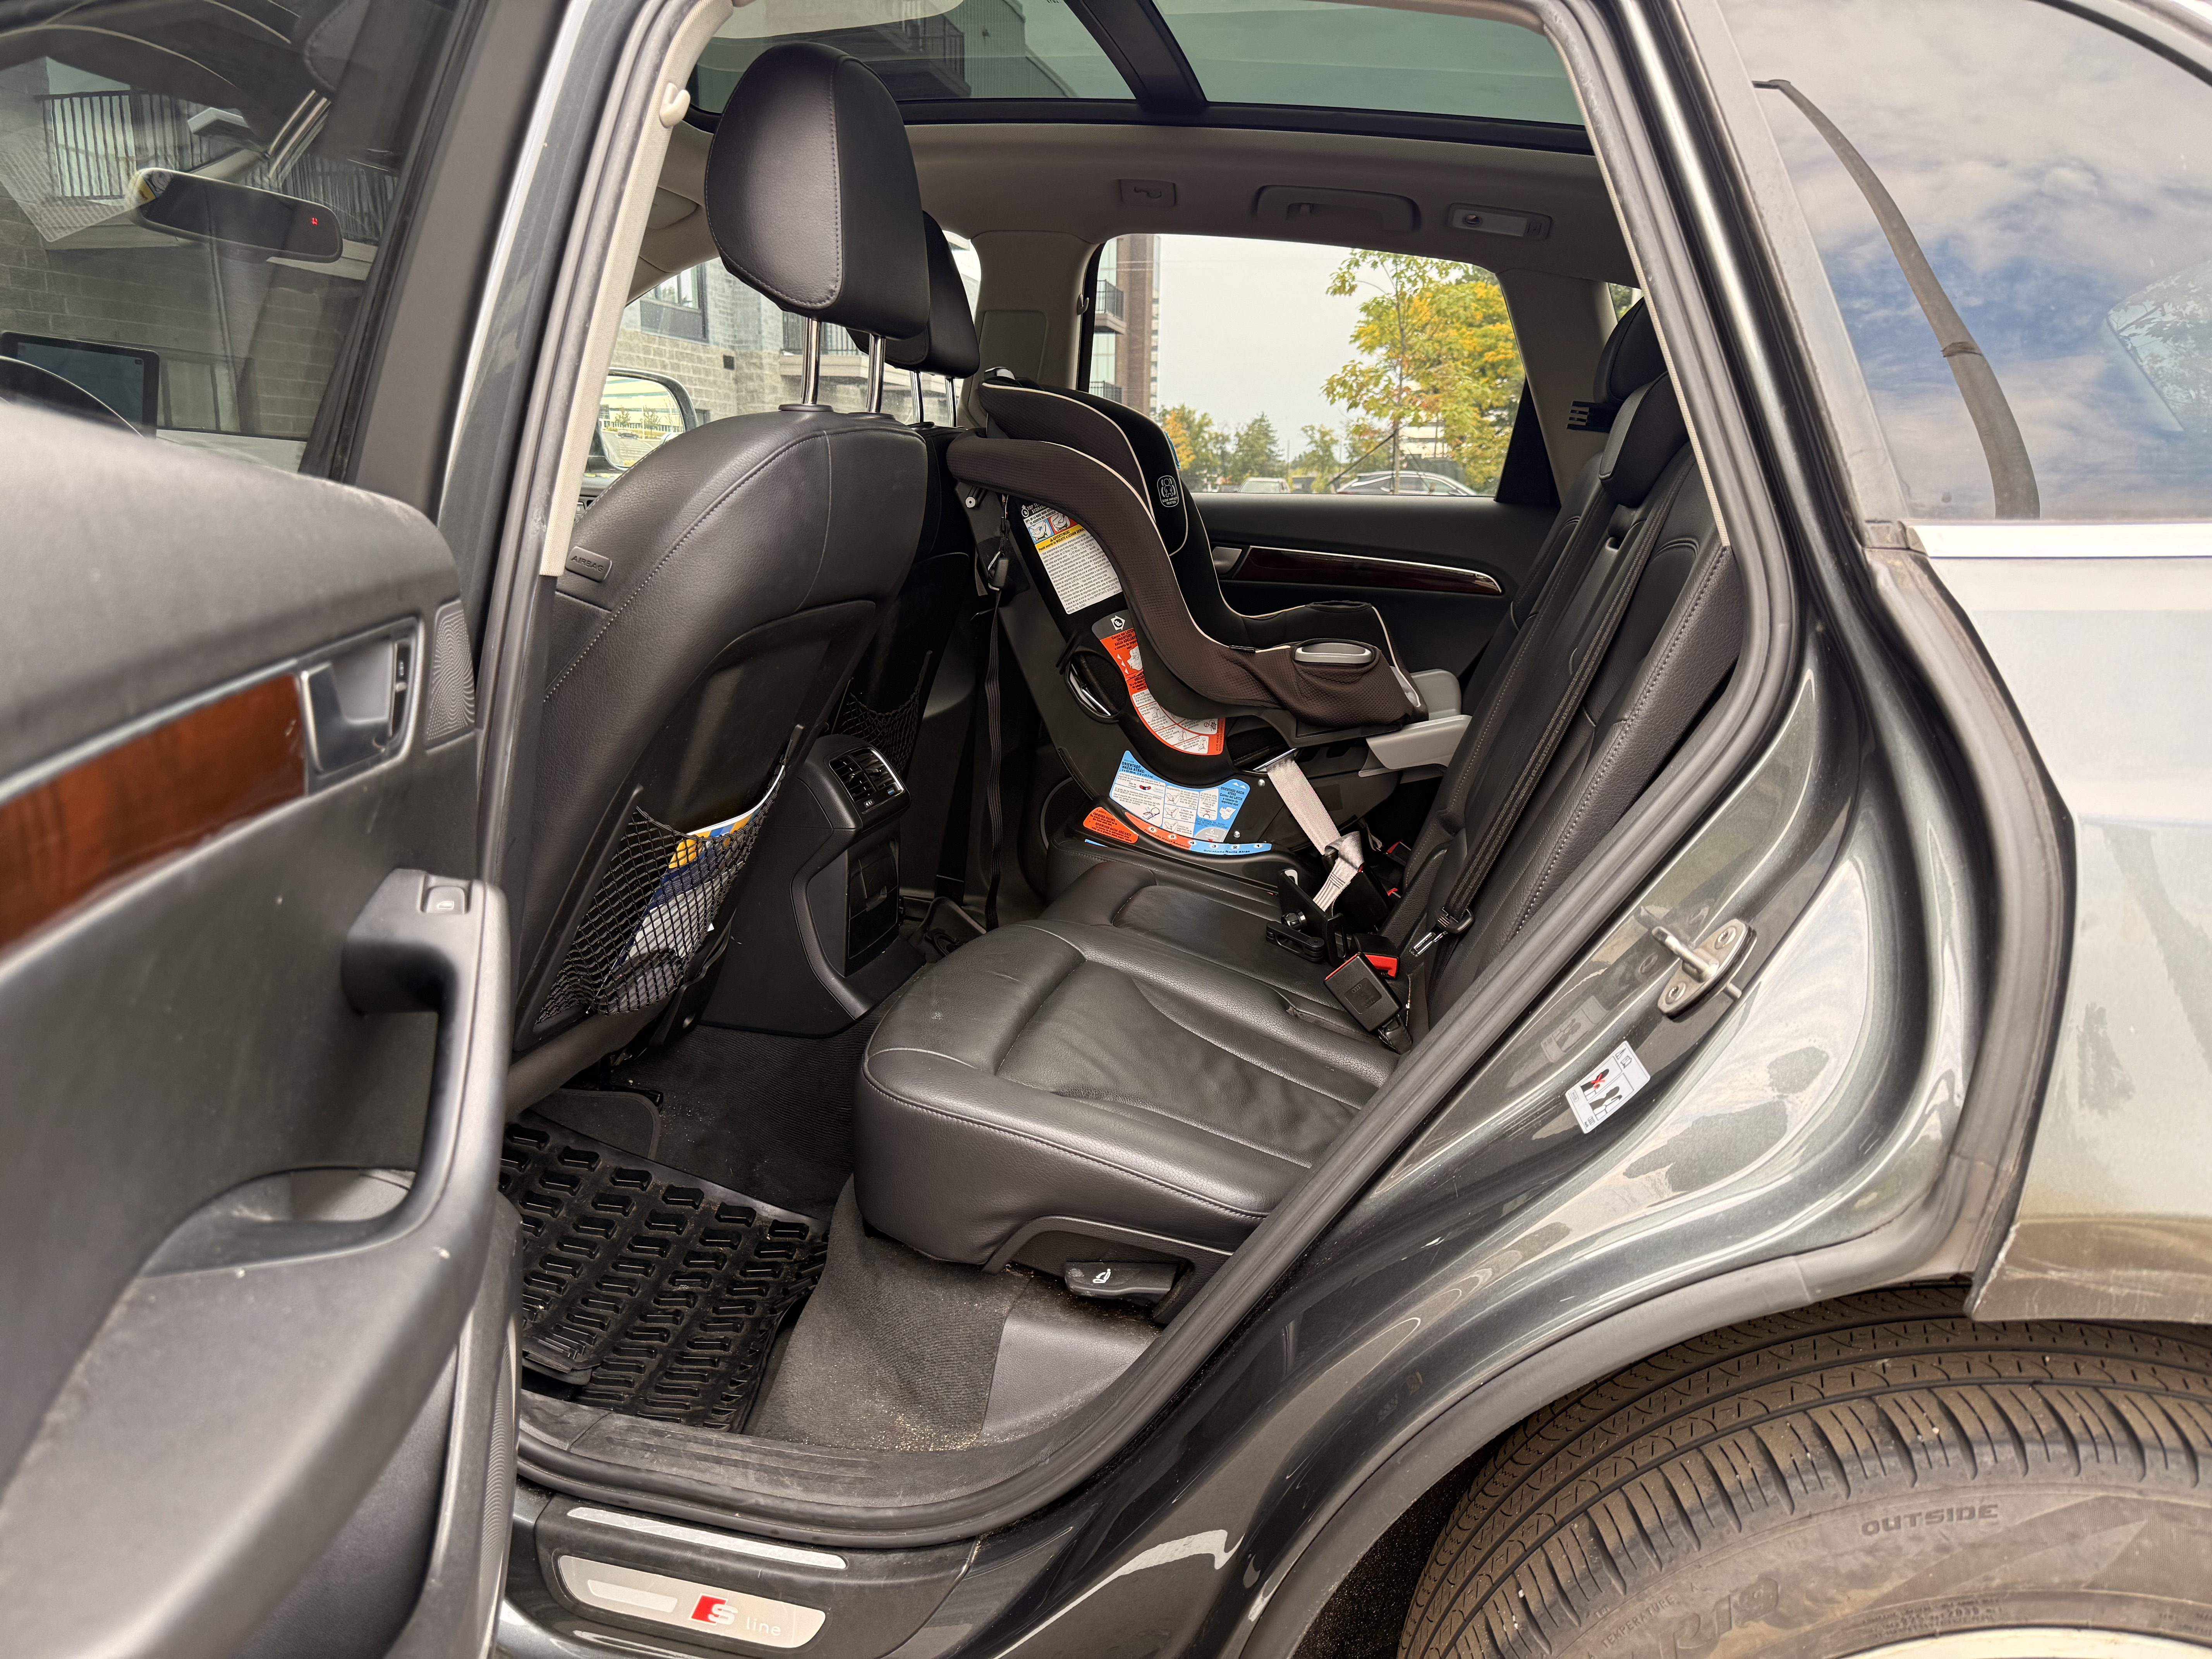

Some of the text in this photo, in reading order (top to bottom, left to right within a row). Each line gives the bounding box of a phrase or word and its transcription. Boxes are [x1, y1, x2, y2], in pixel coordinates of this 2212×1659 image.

[571, 556, 604, 572] AIRBAG
[1861, 1504, 1999, 1537] OUTSIDE
[708, 1603, 782, 1637] S line
[1602, 1594, 1675, 1649] TEMPERATURE
